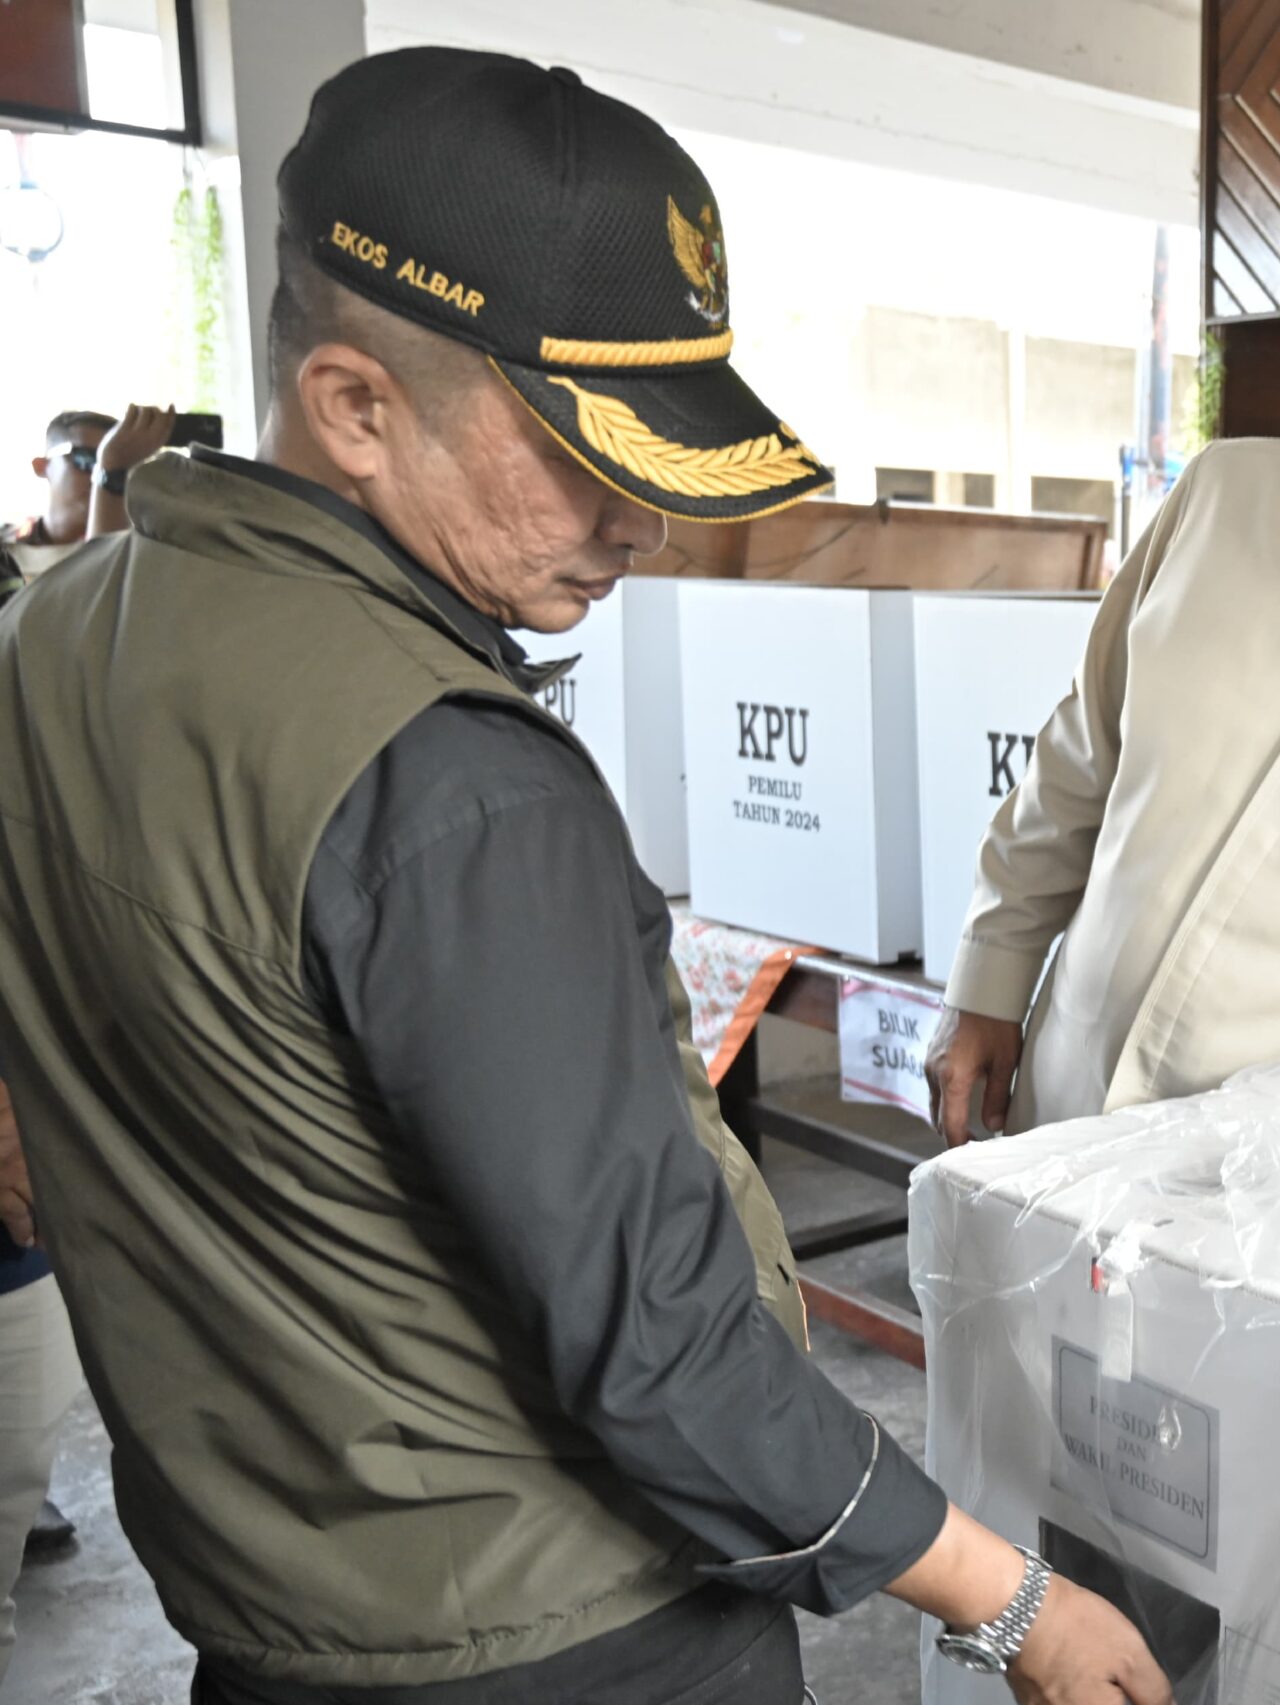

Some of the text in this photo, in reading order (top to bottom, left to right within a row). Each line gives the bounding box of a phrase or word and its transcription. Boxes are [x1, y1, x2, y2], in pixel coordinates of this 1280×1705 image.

[330, 221, 486, 317] EKOS ALBAR
[545, 678, 577, 727] PU
[736, 701, 810, 767] KPU
[748, 775, 803, 802] PEMILU
[733, 800, 822, 832] TAHUN 2024
[878, 1008, 921, 1041] BILIK
[1116, 1435, 1147, 1463] DAN
[1120, 1461, 1205, 1520] PRESIDEN
